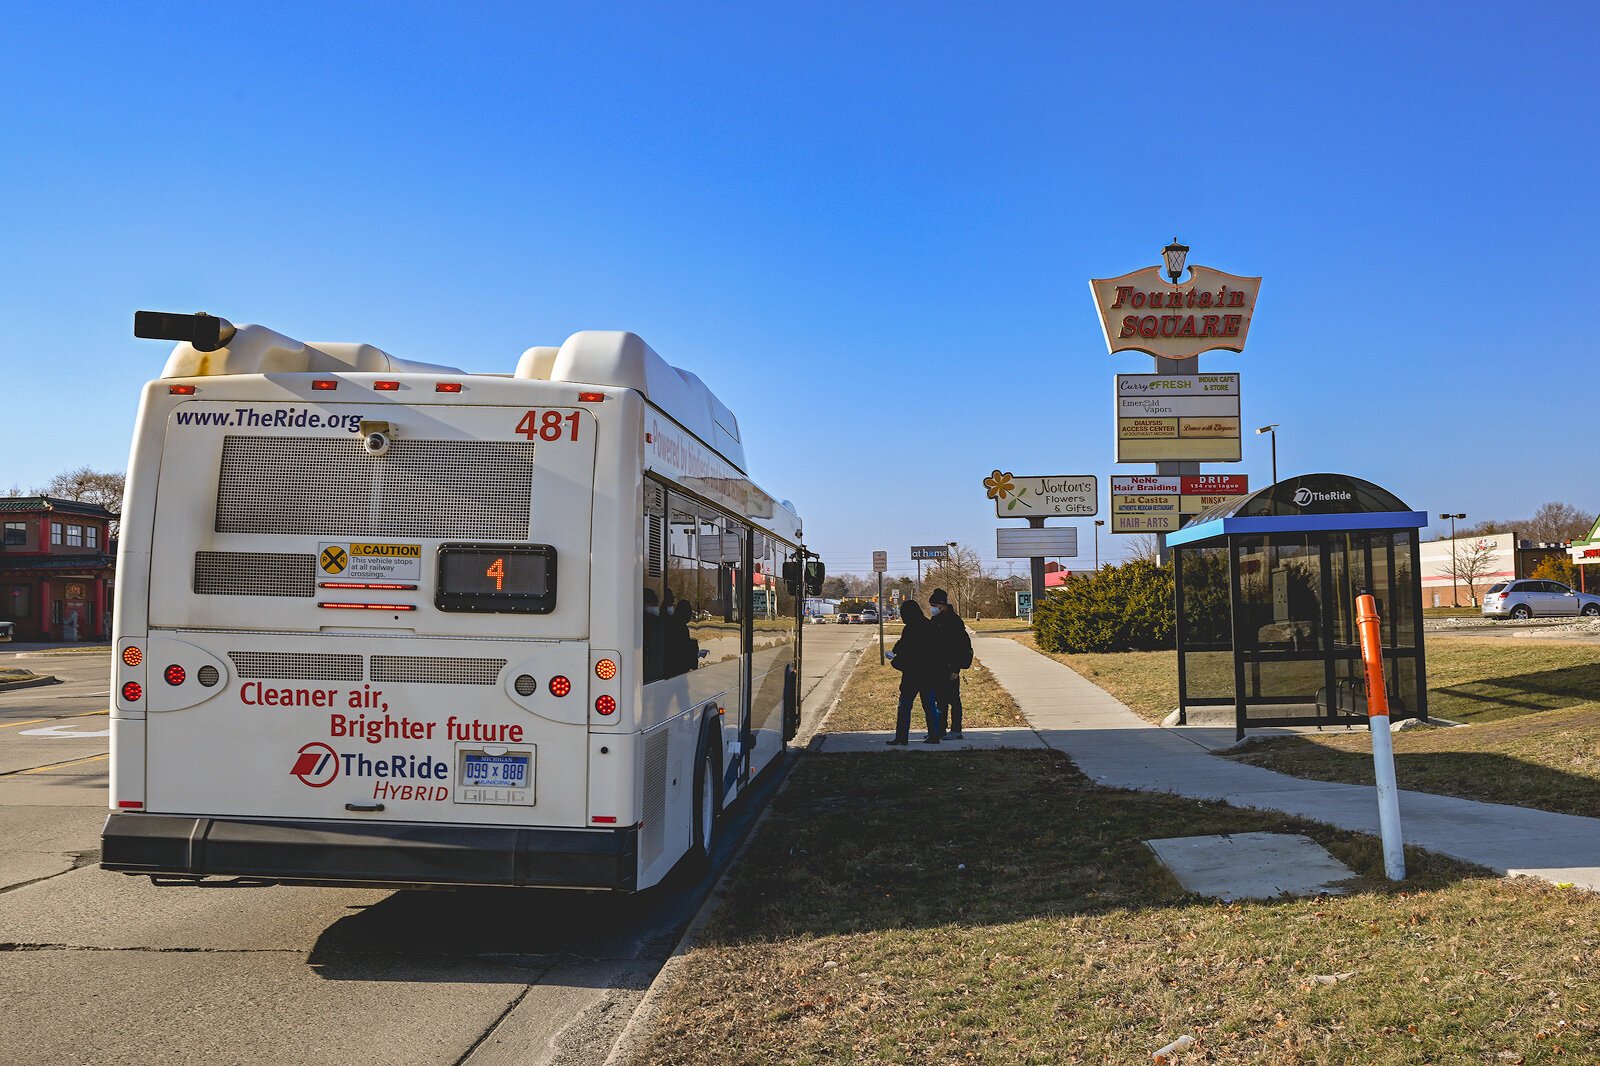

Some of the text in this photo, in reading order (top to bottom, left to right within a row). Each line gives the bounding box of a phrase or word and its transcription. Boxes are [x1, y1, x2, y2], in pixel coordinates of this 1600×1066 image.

[1111, 285, 1245, 308] Fountain
[1118, 314, 1243, 338] SQUARE
[1120, 380, 1191, 392] Curry FRESH
[1144, 406, 1172, 414] Vapors
[176, 407, 363, 433] www.TheRide.org
[515, 410, 581, 442] 481
[1199, 476, 1230, 484] DRIP
[1035, 479, 1092, 496] Norton's
[1137, 484, 1177, 492] Braiding
[1045, 495, 1086, 504] Flowers
[1124, 496, 1168, 504] La Casita
[1312, 490, 1352, 501] TheRide
[1054, 504, 1093, 513] & Gifts
[363, 545, 419, 556] CAUTION
[351, 556, 367, 564] This
[393, 558, 413, 566] stops
[369, 564, 395, 572] railway
[486, 558, 505, 590] 4
[350, 571, 386, 579] crossings.
[240, 681, 389, 712] Cleaner air,
[330, 713, 524, 744] Brighter future
[341, 753, 449, 780] TheRide
[466, 762, 488, 779] 099
[502, 763, 524, 780] 888
[373, 780, 449, 802] HYBRID
[463, 789, 526, 803] GILLIG
